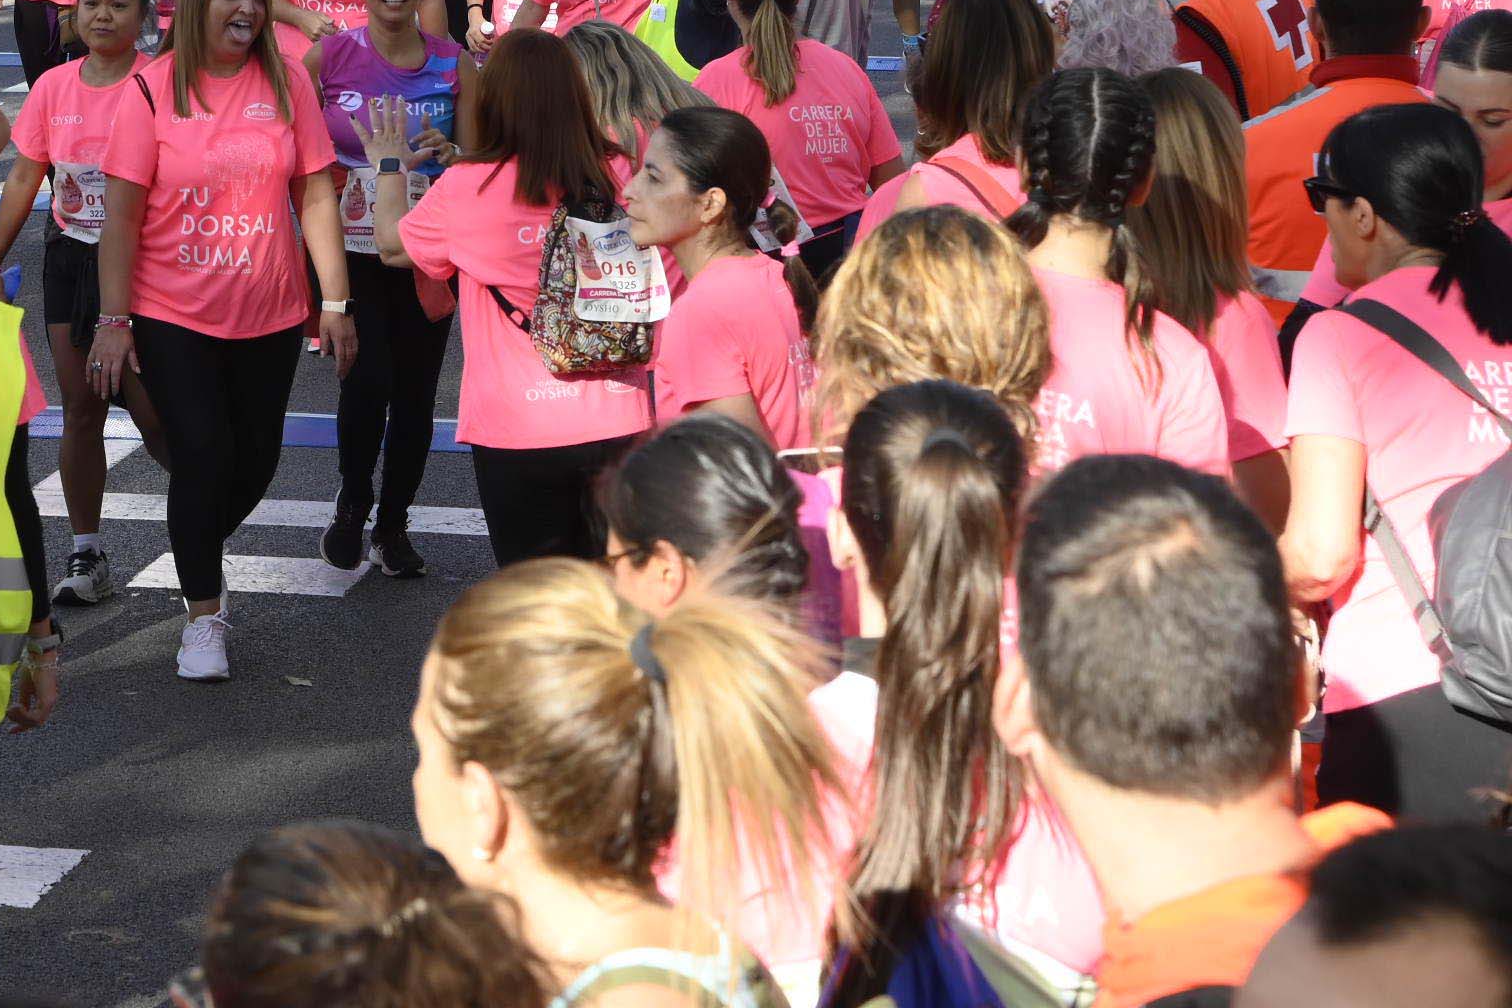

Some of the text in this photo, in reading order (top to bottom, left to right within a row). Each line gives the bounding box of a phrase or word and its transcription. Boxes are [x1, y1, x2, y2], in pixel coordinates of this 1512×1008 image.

[374, 97, 446, 117] ZRICH
[789, 104, 854, 123] CARRERA
[50, 113, 84, 127] OYSHO
[805, 121, 845, 138] DE LA
[805, 138, 849, 155] MUJER
[179, 187, 210, 207] TU
[180, 213, 275, 237] DORSAL
[177, 243, 252, 268] SUMA
[601, 260, 637, 276] 016
[584, 303, 619, 313] OYSHO
[526, 384, 580, 402] OYSHO
